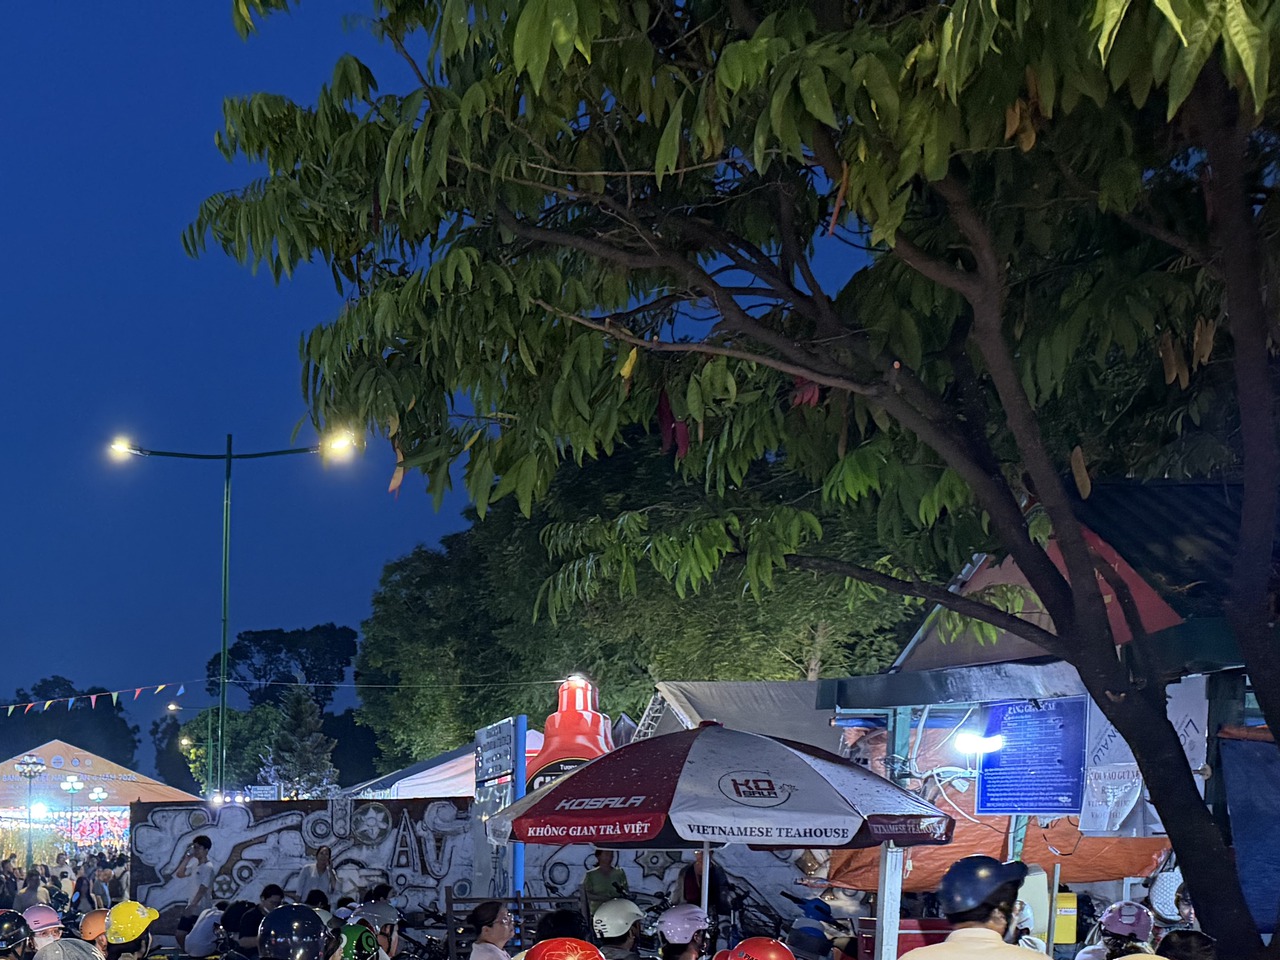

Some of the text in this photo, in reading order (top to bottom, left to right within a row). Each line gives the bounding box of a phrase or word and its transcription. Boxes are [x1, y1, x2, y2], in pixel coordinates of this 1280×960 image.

[555, 795, 646, 811] KOSALA
[527, 822, 650, 837] KHÔNG GIAN TRÀ VIỆT
[688, 824, 850, 839] VIETNAMESE TEAHOUSE
